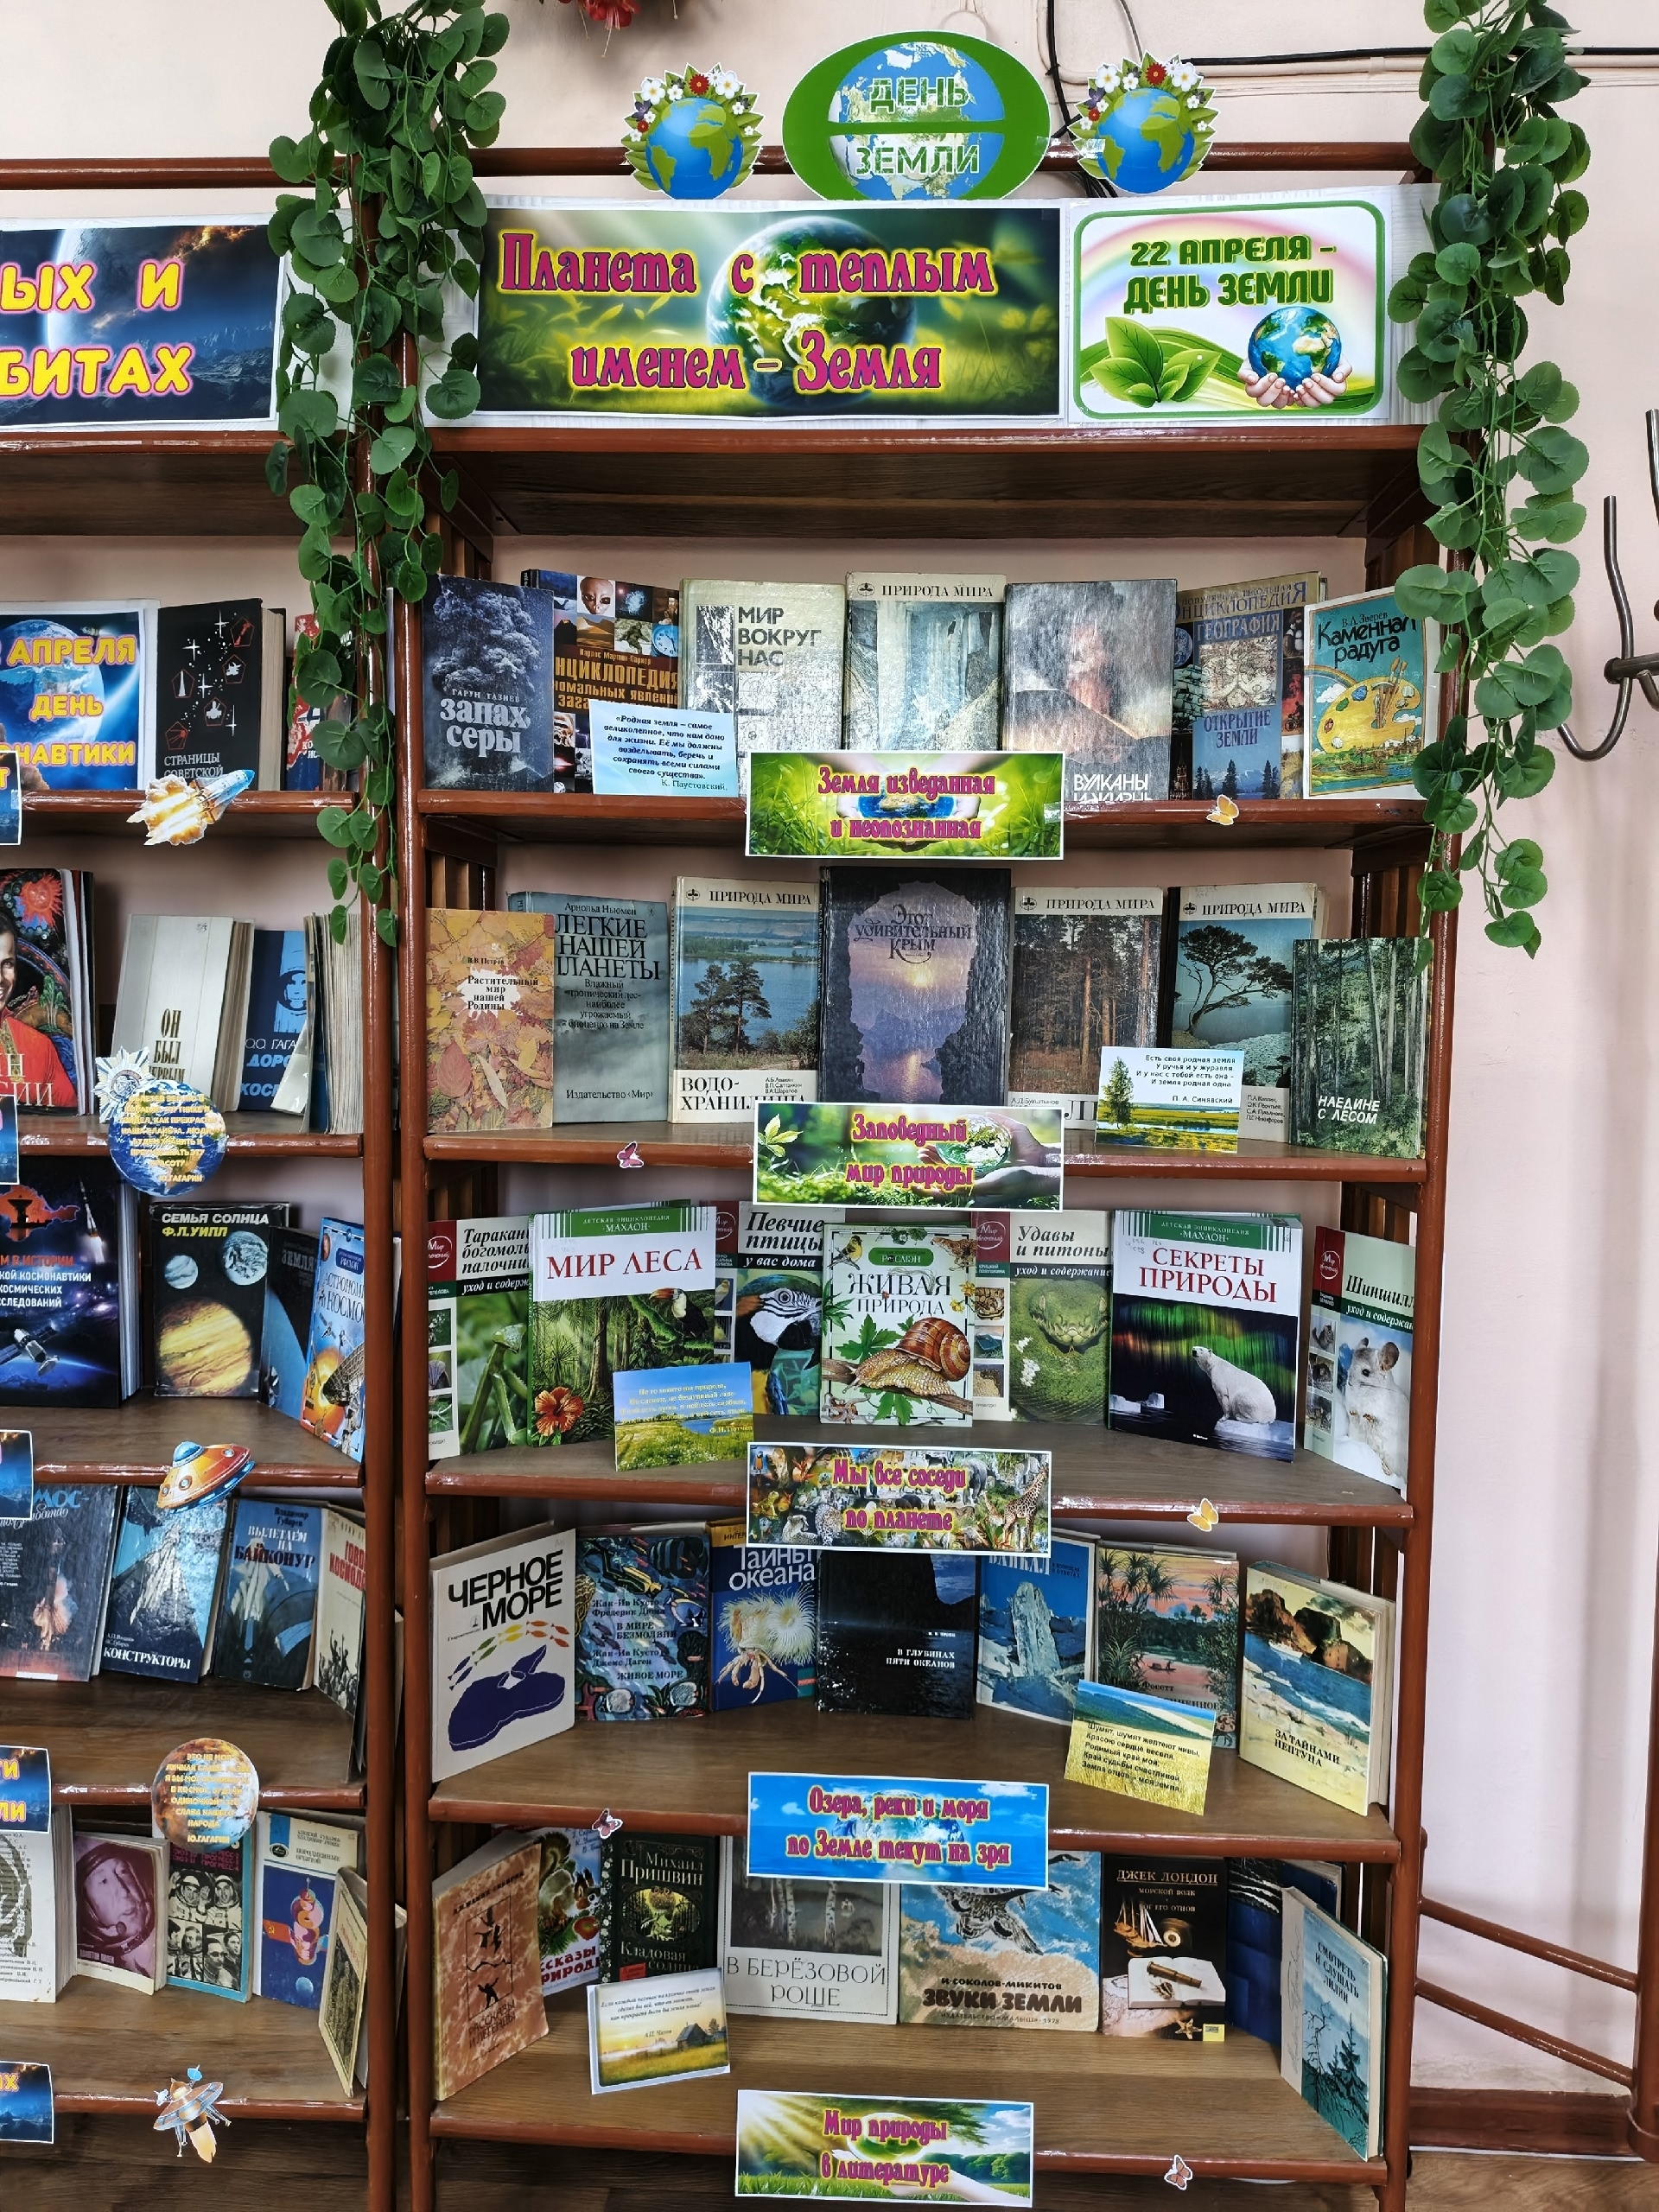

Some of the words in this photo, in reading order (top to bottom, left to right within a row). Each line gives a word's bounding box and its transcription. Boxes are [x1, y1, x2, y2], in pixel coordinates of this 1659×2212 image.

[870, 76, 969, 113] ДЕНЬ
[855, 143, 980, 175] ЗЕМЛИ
[1131, 241, 1171, 267] 22
[1179, 234, 1312, 266] АПРЕЛЯ
[500, 232, 697, 294] Планета
[731, 255, 755, 295] с
[798, 251, 995, 294] теплым
[139, 262, 182, 310] И
[1124, 276, 1210, 315] ДЕНЬ
[1218, 270, 1333, 307] ЗЕМЛИ
[570, 345, 746, 389] именем
[797, 328, 941, 391] Земля
[881, 584, 950, 597] ПРИРОДА
[954, 585, 993, 598] МИРА
[738, 606, 784, 624] МИР
[738, 628, 821, 647] ВОКРУГ
[1197, 616, 1280, 641] ГЕОГРАФИЯ
[7, 636, 137, 665] АПРЕЛЯ
[738, 650, 784, 666] НАС
[1334, 636, 1400, 668] радуга
[555, 657, 679, 690] НЦИКЛОПЕДИЯ
[452, 689, 480, 698] ГАРУН
[30, 694, 104, 721] ДЕНЬ
[604, 725, 664, 736] великолепное,
[1204, 710, 1271, 732] ОТКРЫТИЕ
[446, 726, 521, 758] серы
[625, 737, 656, 746] жизни.
[688, 741, 722, 750] должны
[1217, 729, 1258, 748] ЗЕМЛИ
[164, 753, 220, 766] СТРАНИЦЫ
[613, 756, 659, 766] сохранять
[689, 762, 721, 771] силами
[818, 766, 879, 794] Земля
[887, 767, 995, 801] изведанная
[1074, 774, 1148, 791] ВУЛКАНЫ
[830, 820, 842, 838] и
[849, 818, 982, 839] неопознанная
[709, 890, 772, 904] ПРИРОДА
[776, 893, 811, 905] МИРА
[1046, 899, 1110, 911] ПРИРОДА
[1115, 899, 1154, 910] МИРА
[564, 902, 601, 913] Арнольд
[602, 905, 638, 916] Ньюмен
[1202, 902, 1262, 917] ПРИРОДА
[1267, 901, 1306, 914] МИРА
[554, 913, 647, 938] ЛЕГКИЕ
[559, 935, 645, 959] НАШЕЙ
[467, 975, 538, 986] Растительный
[486, 986, 506, 995] мир
[585, 979, 624, 988] Влажный
[467, 1001, 505, 1011] Родины
[473, 994, 505, 1003] нашей
[586, 1000, 625, 1009] наиболее
[161, 1009, 181, 1038] ОН
[580, 1010, 631, 1020] угрожаемый
[154, 1039, 181, 1064] БЫЛ
[566, 1090, 626, 1099] Издательство
[681, 1077, 740, 1094] ВОДО-
[1192, 1096, 1233, 1104] Синявский
[1318, 1096, 1380, 1111] НАЕДИНЕ
[1318, 1109, 1325, 1120] С
[1332, 1109, 1377, 1124] ЛЕСОМ
[851, 1114, 967, 1146] Заповедный
[846, 1165, 884, 1184] мир
[890, 1165, 973, 1190] природы
[162, 1213, 208, 1224] СЕМЬЯ
[213, 1213, 269, 1225] СОЛНЦА
[746, 1211, 825, 1234] Певчие
[1018, 1226, 1074, 1243] Удавы
[746, 1236, 823, 1254] птицы
[1033, 1244, 1109, 1257] питоны
[22, 1255, 74, 1267] ИСТОРИИ
[547, 1254, 615, 1280] МИР
[623, 1248, 702, 1274] ЛЕСА
[755, 1256, 779, 1267] вас
[781, 1255, 817, 1268] дома
[1153, 1248, 1264, 1276] СЕКРЕТЫ
[19, 1272, 92, 1282] КОСМОНАВТИКИ
[1014, 1267, 1038, 1277] уход
[461, 1281, 484, 1295] уход
[848, 1272, 952, 1296] ЖИВАЯ
[1140, 1267, 1277, 1303] ПРИРОДЫ
[855, 1298, 944, 1315] ПРИРОДА
[1346, 1305, 1364, 1315] уход
[833, 1459, 866, 1484] Мы
[874, 1460, 901, 1485] все
[908, 1469, 966, 1493] соседи
[846, 1511, 866, 1528] по
[874, 1511, 952, 1530] планете
[247, 1524, 308, 1543] ВЫЛЕТАЕМ
[235, 1542, 315, 1568] БАЙКОНУР
[448, 1549, 563, 1608] ЧЕРНОЕ
[729, 1564, 816, 1591] океана
[482, 1579, 563, 1630] МОРЕ
[617, 1630, 677, 1639] БЕЗМОЛВИЯ
[104, 1647, 191, 1669] КОНСТРУКТОРЫ
[906, 1649, 955, 1659] ГЛУБИНАХ
[913, 1659, 956, 1669] ОКЕАНОВ
[1086, 1732, 1115, 1745] Красою
[1117, 1741, 1143, 1753] сердце
[1088, 1722, 1115, 1736] Шумят,
[1116, 1731, 1141, 1741] шумят
[1143, 1738, 1176, 1750] желтеют
[1275, 1728, 1287, 1741] ЗА
[1289, 1733, 1340, 1764] ТАЙНАМИ
[1084, 1751, 1102, 1762] Край
[1103, 1756, 1132, 1770] судьбы
[1085, 1742, 1120, 1757] Родимый
[1122, 1751, 1140, 1762] край
[1275, 1739, 1322, 1767] НЕПТУНА
[1082, 1761, 1106, 1772] Земля
[810, 1786, 867, 1817] Озера,
[874, 1796, 916, 1819] реки
[923, 1798, 934, 1815] и
[942, 1800, 988, 1824] моря
[787, 1837, 809, 1855] по
[817, 1830, 872, 1858] Земле
[879, 1840, 942, 1865] текут
[949, 1843, 970, 1862] на
[977, 1845, 1010, 1868] зря
[645, 1852, 703, 1872] Михаил
[620, 1859, 703, 1886] Пришвин
[1117, 1869, 1158, 1882] ДЖЕК
[1161, 1871, 1217, 1885] ЛОНДОН
[1139, 1887, 1173, 1896] МОРСКОЙ
[620, 1944, 686, 1962] Кладовая
[1318, 1942, 1357, 1982] СМОТРЕТЬ
[728, 1956, 740, 1974] В
[747, 1956, 886, 1986] БЕРЁЗОВОЙ
[1322, 1960, 1359, 1999] СЛУШАТЬ
[771, 1985, 840, 2009] РОЩЕ
[923, 1988, 998, 2011] ЗВУКИ
[1001, 1992, 1082, 2014] ЗЕМЛИ
[824, 2109, 862, 2139] Мир
[868, 2118, 947, 2145] природы
[821, 2152, 830, 2179] в
[837, 2161, 949, 2189] литературе
